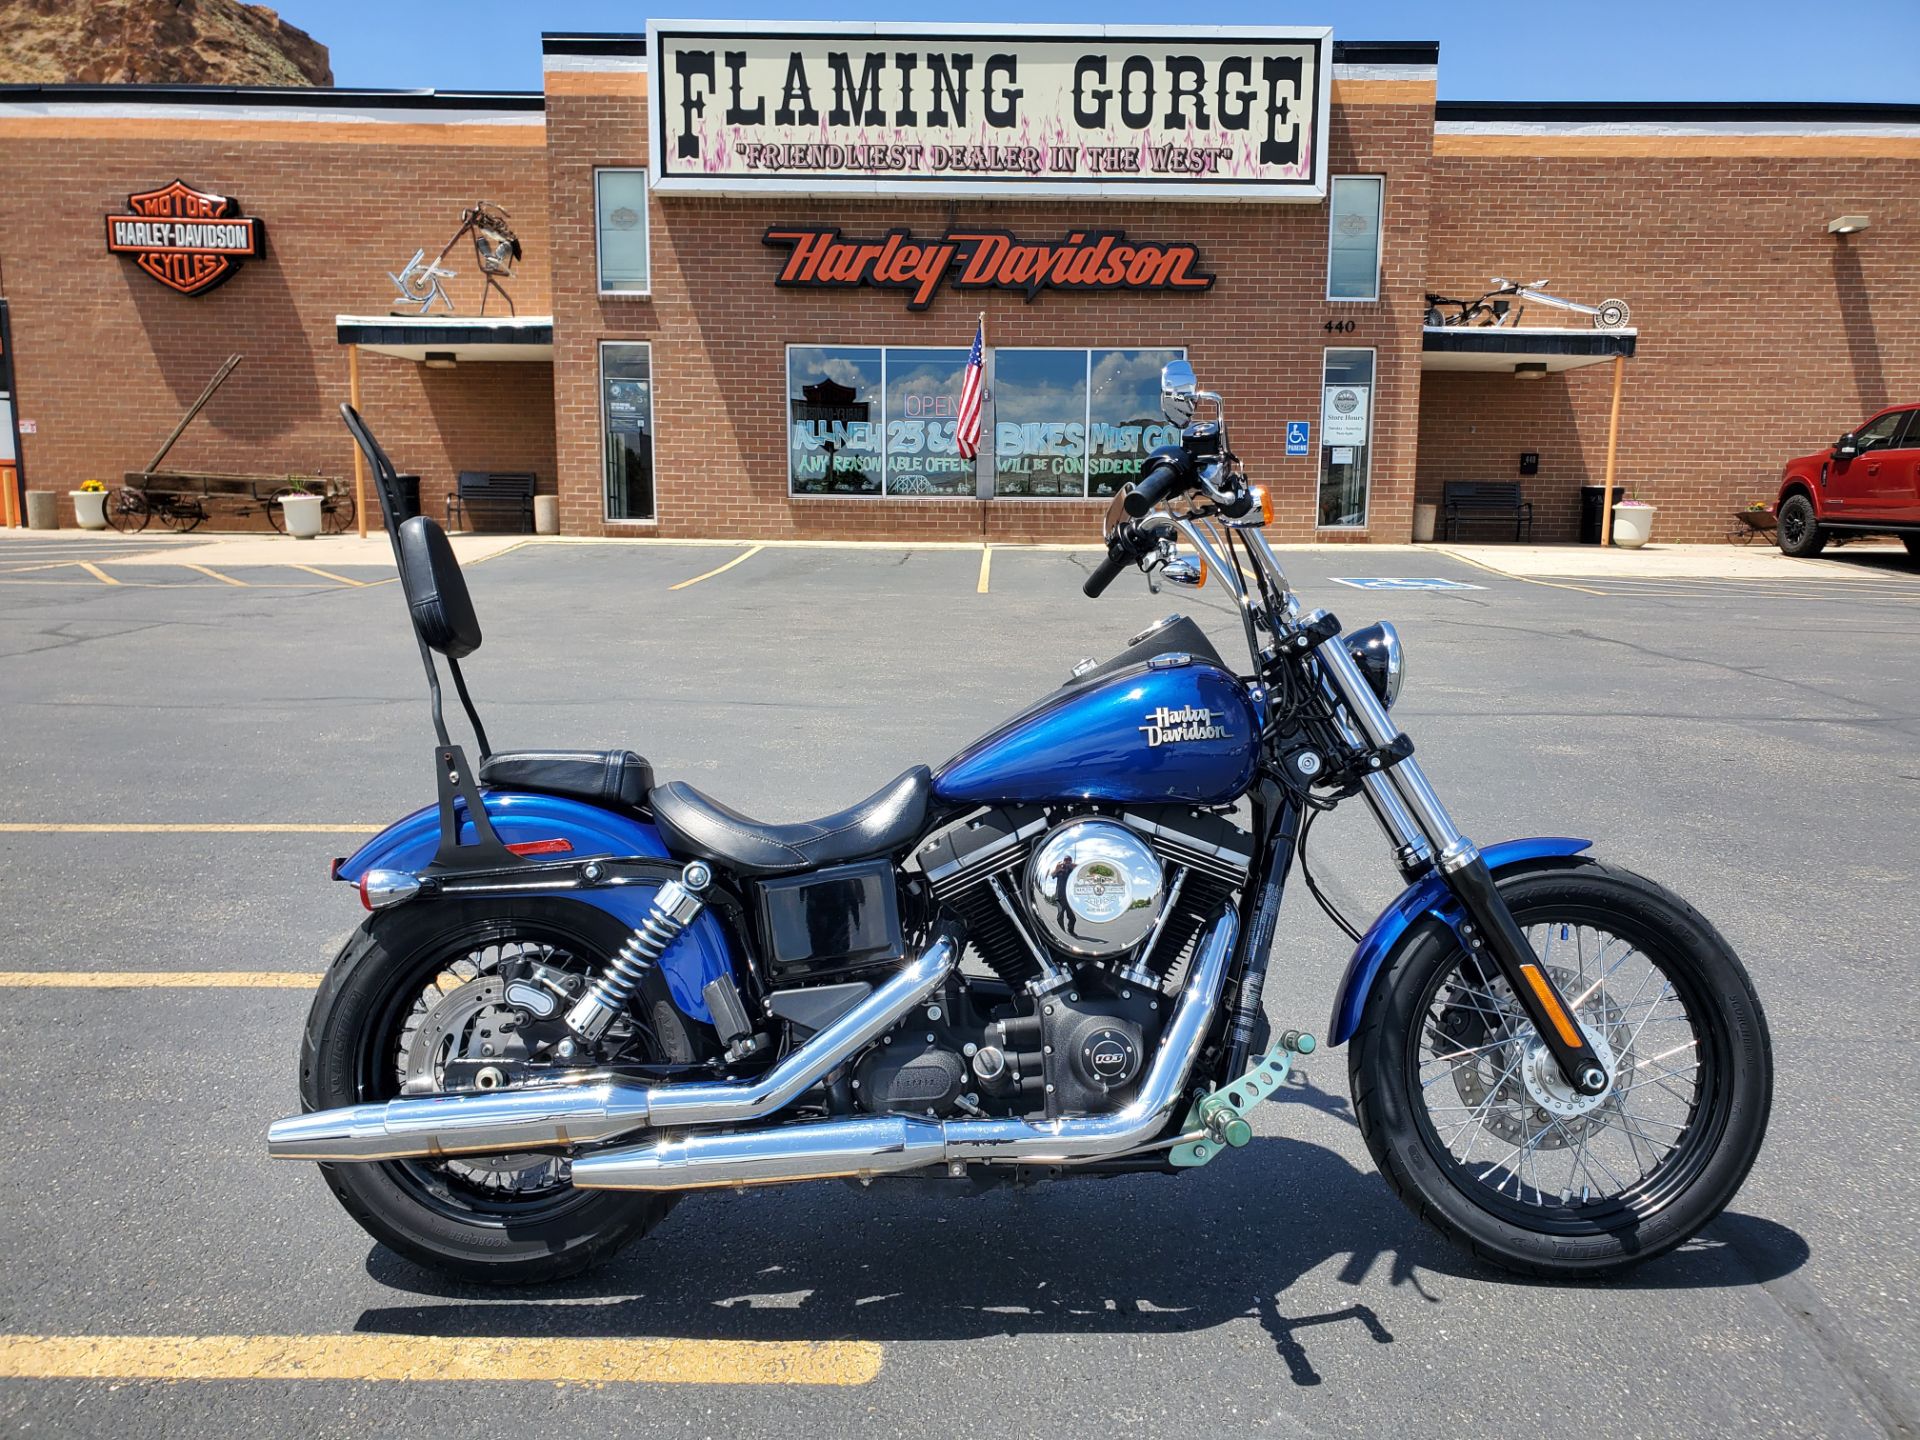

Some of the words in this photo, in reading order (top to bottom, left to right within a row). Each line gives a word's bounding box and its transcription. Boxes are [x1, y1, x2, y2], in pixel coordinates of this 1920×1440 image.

[675, 50, 1025, 160] FLAMING
[1071, 54, 1304, 167] GORGE
[931, 145, 1041, 174] DEALER
[1049, 147, 1079, 174] IN
[1087, 147, 1141, 175] THE
[1148, 147, 1233, 176] WEST"
[144, 189, 214, 217] MOTOR
[115, 222, 248, 249] HARLEY-DAVIDSON
[149, 254, 217, 285] CYCLES
[767, 230, 1210, 304] Harley-Davidson
[1324, 320, 1356, 334] 440
[907, 396, 960, 417] OPEN
[943, 421, 960, 455] 2
[995, 422, 1086, 458] BIKES
[799, 455, 829, 473] ANY
[925, 457, 974, 473] OFFER
[995, 456, 1032, 474] WILL
[1033, 459, 1048, 471] BE
[1146, 704, 1225, 728] Harley
[1139, 721, 1234, 747] Davidson
